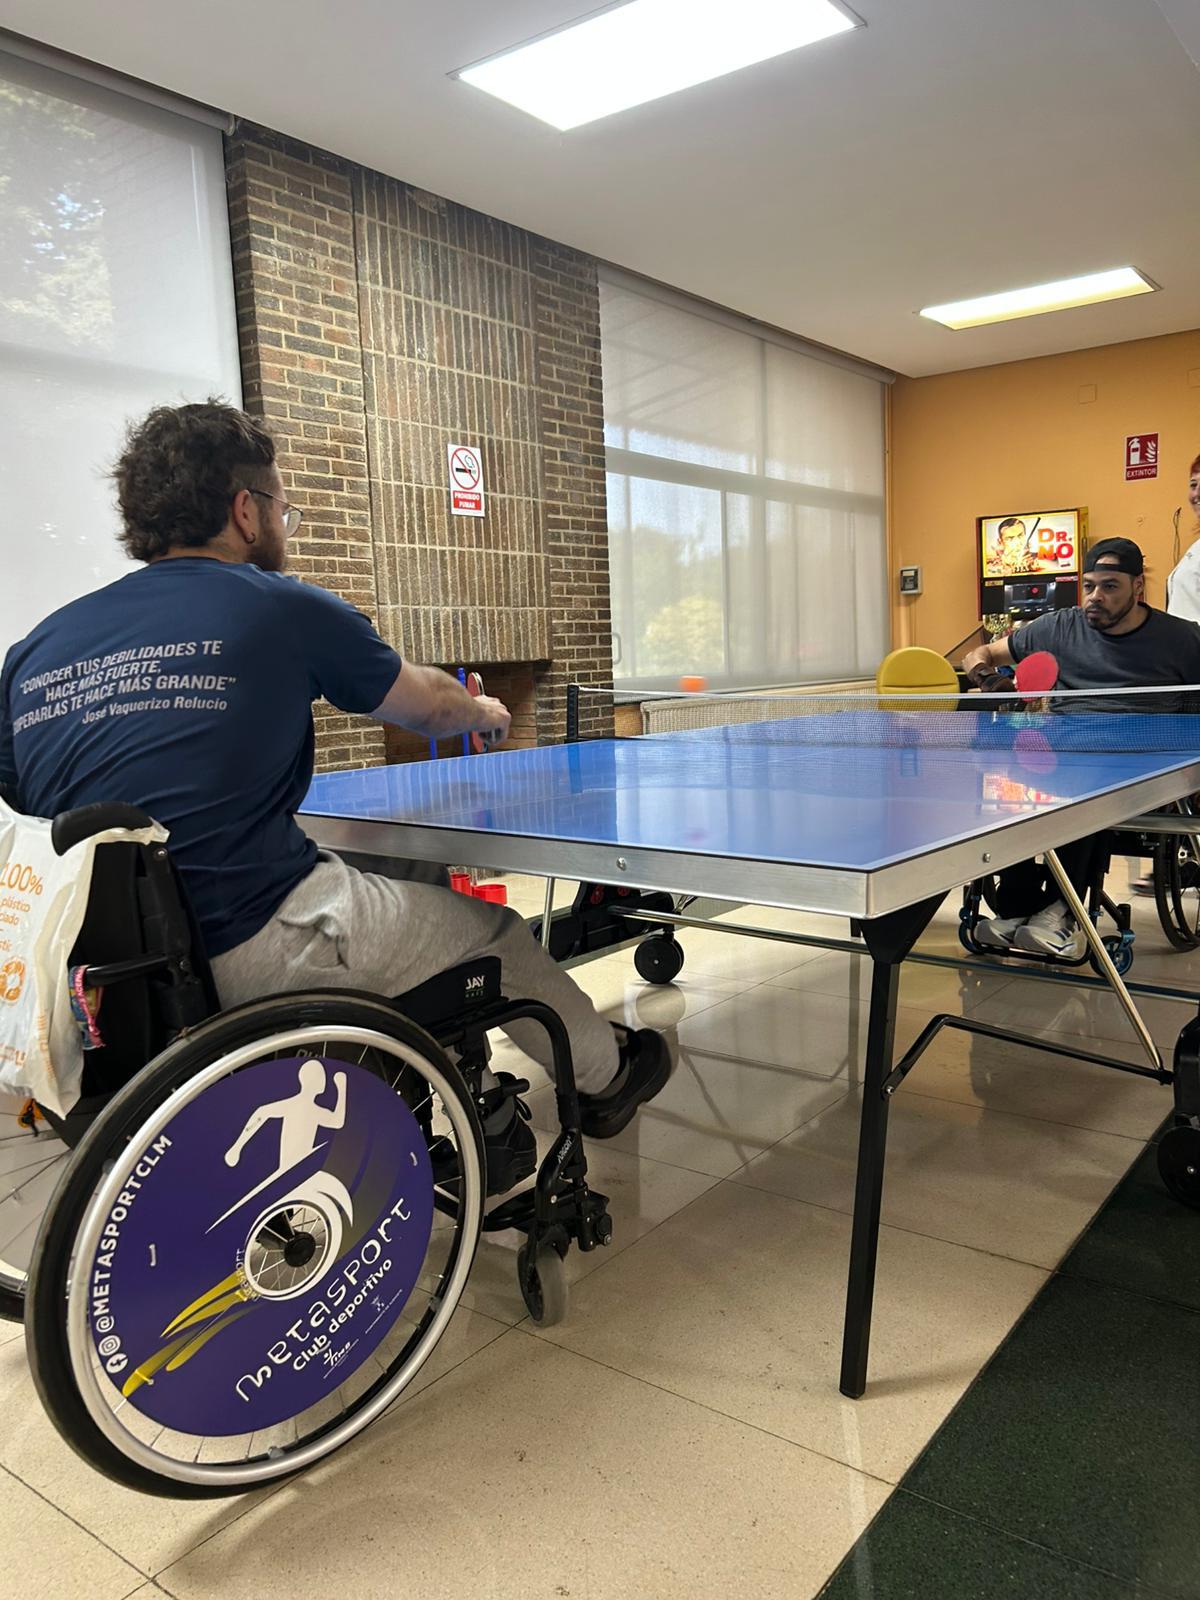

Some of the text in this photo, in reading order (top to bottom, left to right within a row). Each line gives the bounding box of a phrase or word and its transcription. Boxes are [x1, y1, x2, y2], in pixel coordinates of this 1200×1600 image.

[1126, 468, 1156, 478] EXTINTOR
[1037, 527, 1072, 542] DR.
[1037, 543, 1074, 561] NO
[75, 657, 101, 677] TUS
[101, 641, 197, 669] DEBILIDADES
[201, 639, 223, 656] TE
[45, 680, 79, 702] HACE
[104, 660, 161, 682] FUERTE,
[70, 693, 85, 712] TE
[84, 682, 117, 705] HACE
[117, 673, 153, 695] MÁS
[82, 695, 228, 725] José Vaquerizo Relucio
[0, 863, 44, 896] 100%
[465, 975, 486, 990] JAY
[93, 1134, 173, 1333] @METASPORTCLM
[292, 1333, 328, 1371] Club
[328, 1258, 393, 1334] deportivo
